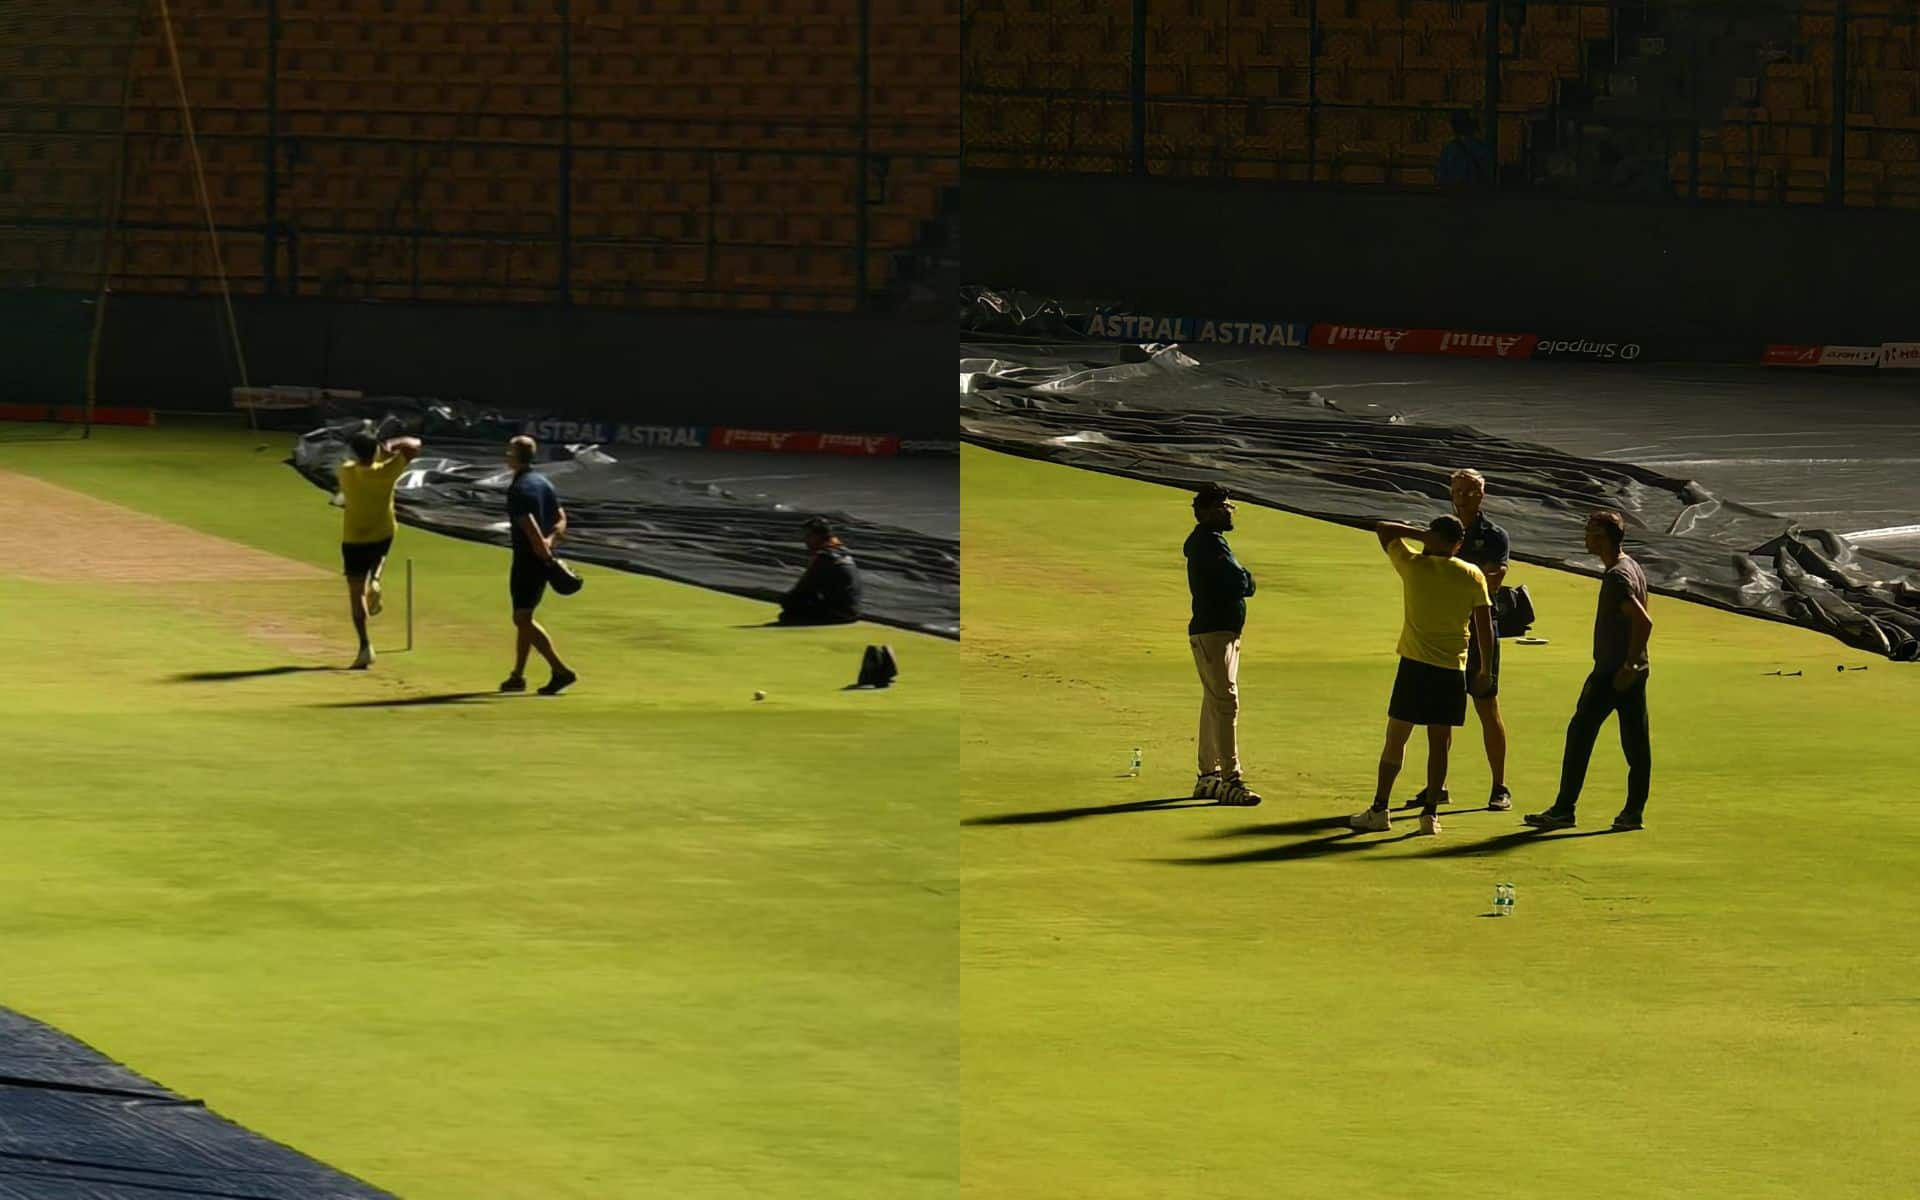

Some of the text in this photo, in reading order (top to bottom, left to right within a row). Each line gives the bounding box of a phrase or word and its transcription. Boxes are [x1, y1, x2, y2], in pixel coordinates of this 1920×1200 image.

[1087, 315, 1187, 341] ASTRAL
[1201, 320, 1301, 346] ASTRAL
[1328, 325, 1409, 351] Amul
[1440, 332, 1522, 357] Amul
[1537, 339, 1618, 358] Simpolo
[525, 420, 608, 443] ASTRAL
[616, 426, 701, 447] ASTRAL
